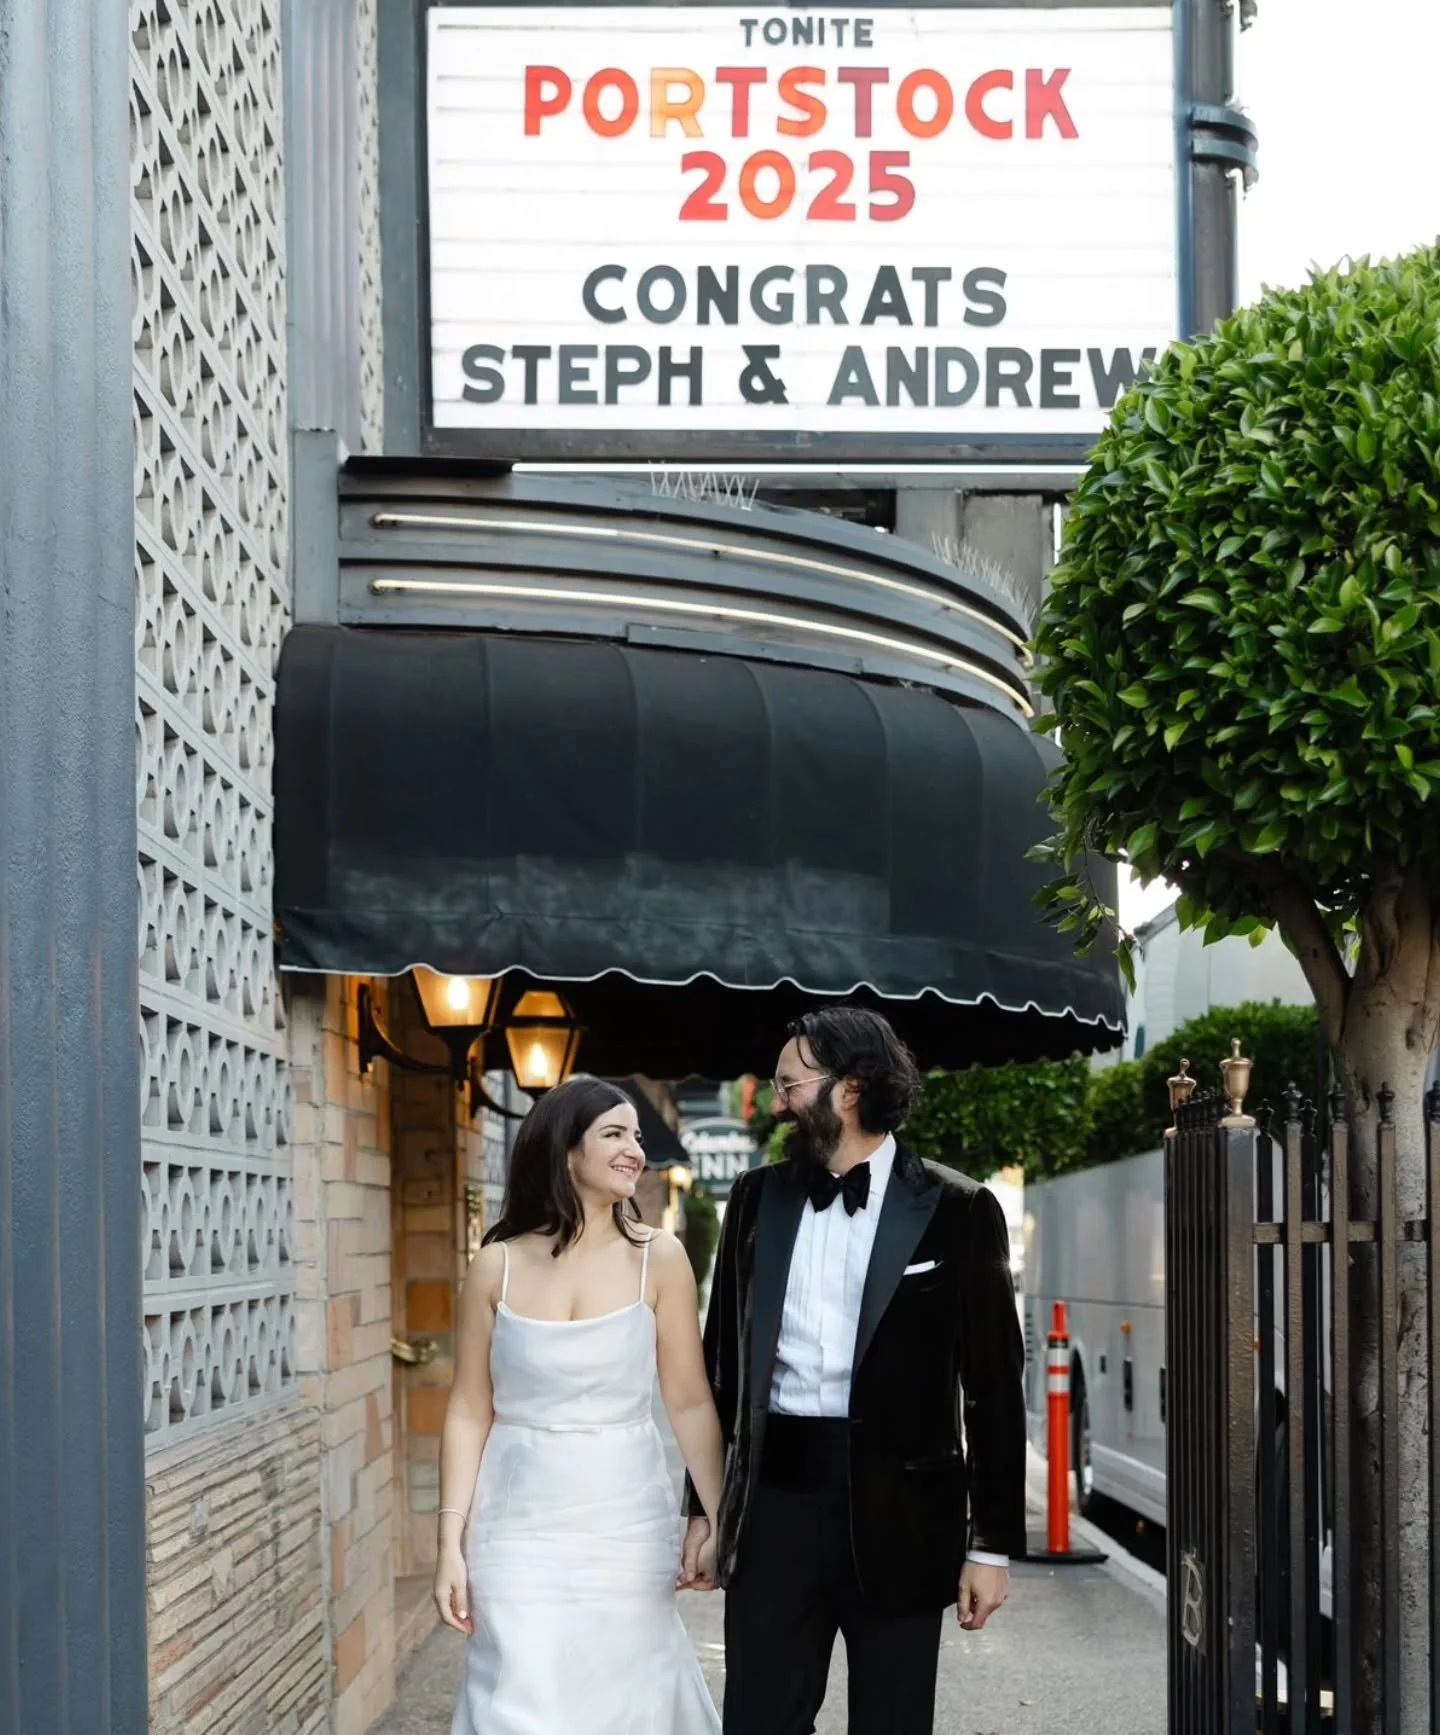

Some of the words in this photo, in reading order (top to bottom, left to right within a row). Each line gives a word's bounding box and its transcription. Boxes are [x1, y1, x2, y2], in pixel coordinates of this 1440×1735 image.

[740, 17, 874, 48] TONITE
[524, 65, 1079, 140] PORTSTOCK
[678, 149, 916, 222] 2025
[582, 264, 1007, 327] CONGRATS
[461, 344, 703, 407] STEPH
[738, 345, 790, 405] &
[827, 345, 1157, 408] ANDREW
